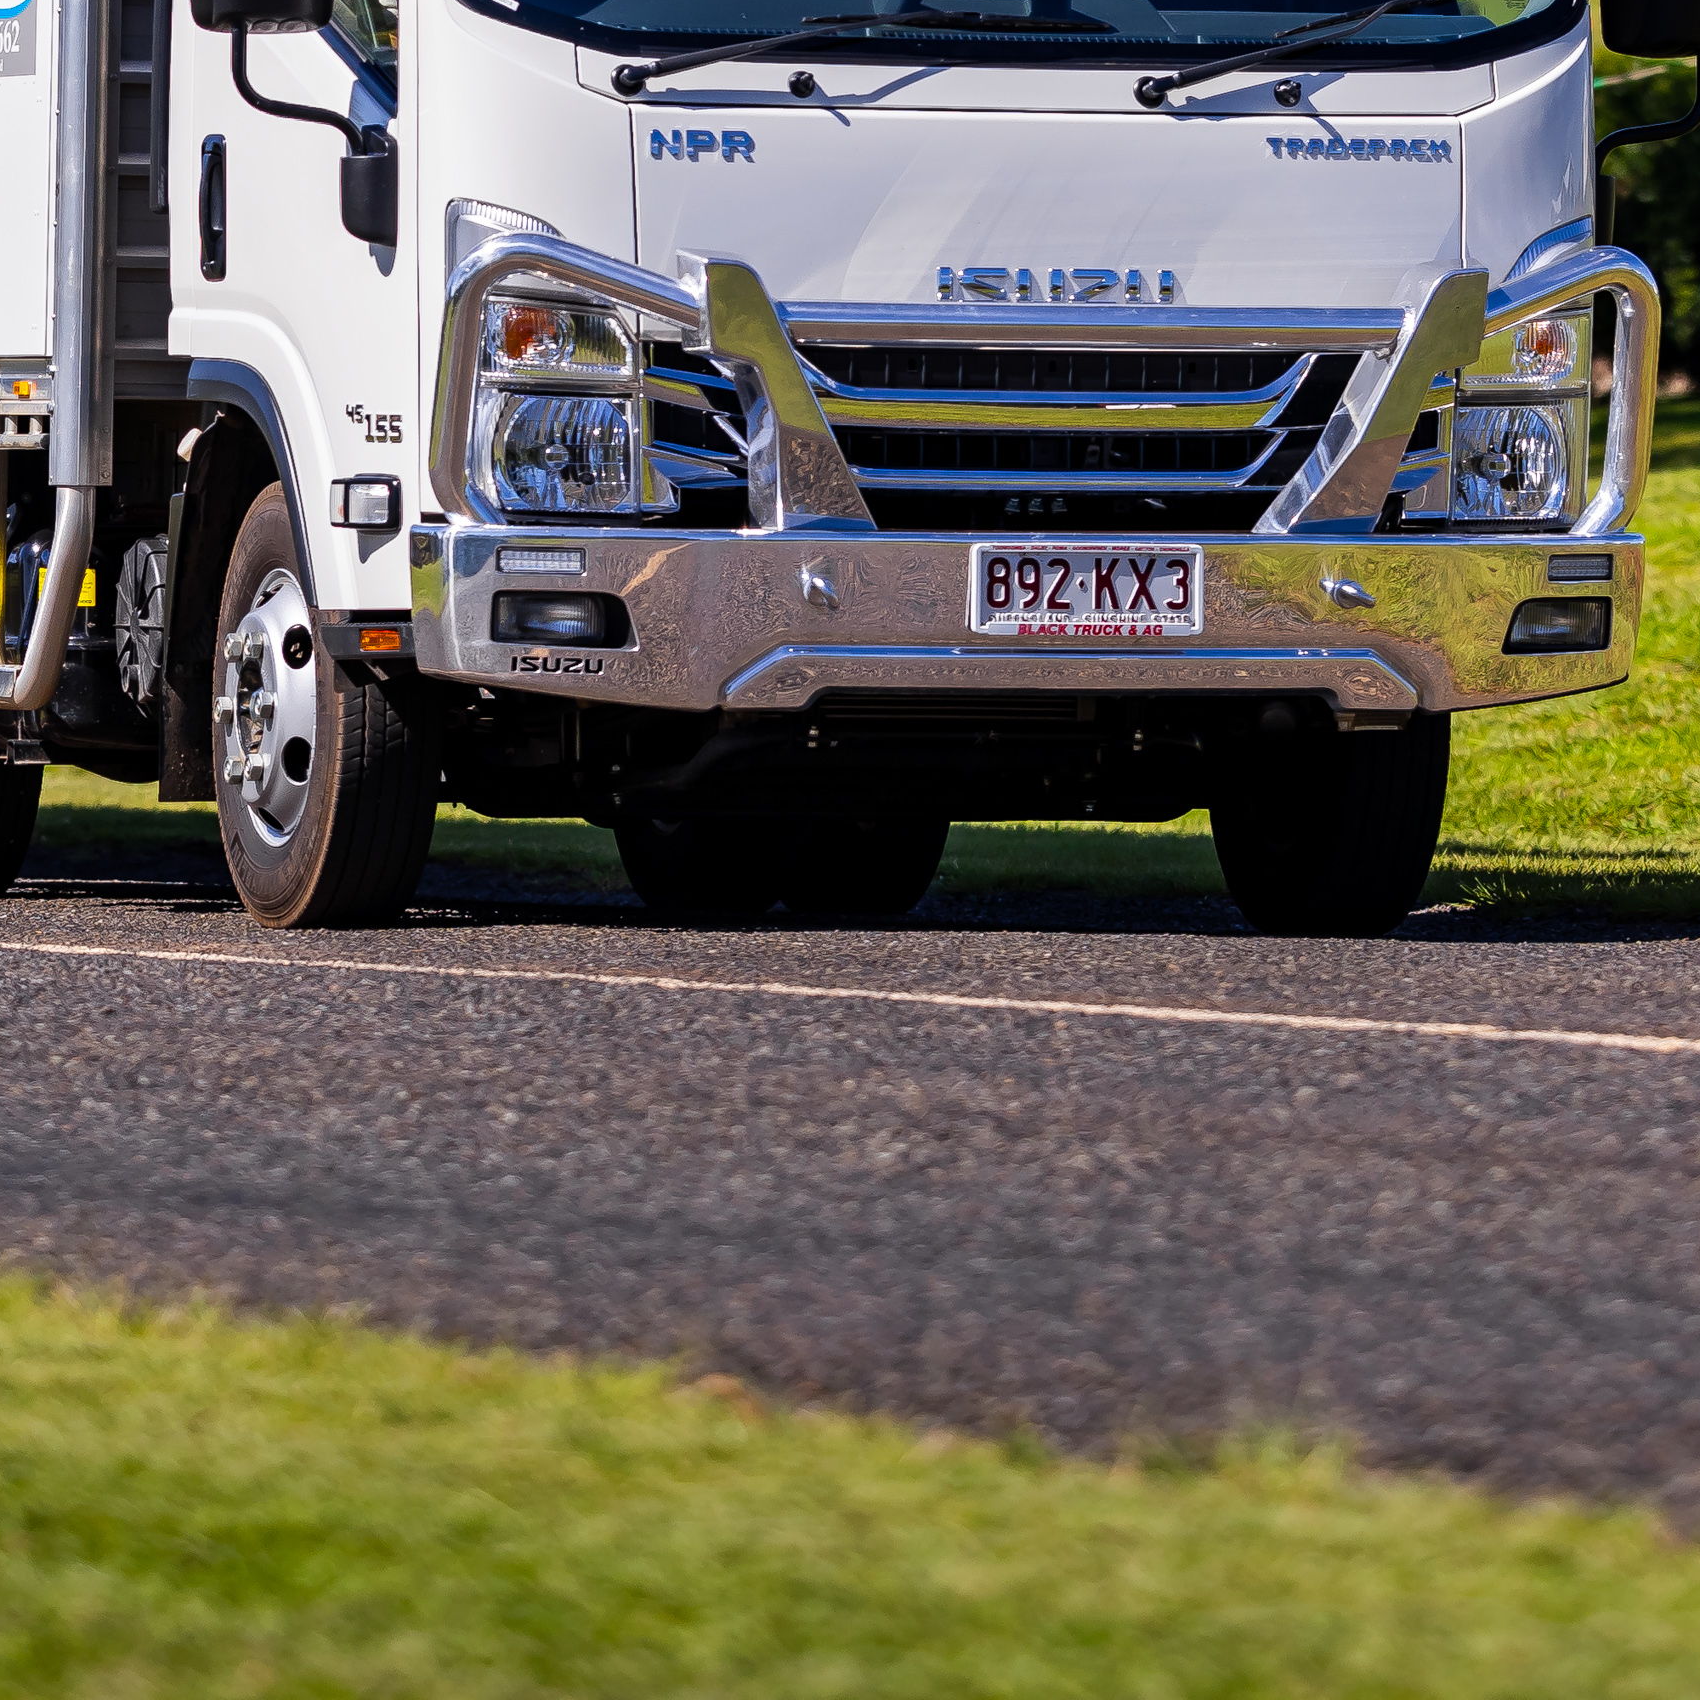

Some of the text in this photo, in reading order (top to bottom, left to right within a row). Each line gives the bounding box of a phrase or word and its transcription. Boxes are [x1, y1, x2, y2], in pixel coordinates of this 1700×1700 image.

[650, 129, 756, 162] NPR
[1266, 137, 1453, 162] TRADEPACK
[936, 266, 1174, 304] ISUZU
[346, 404, 403, 444] 45 155
[1017, 623, 1163, 636] BLACK TRUCK & AG
[510, 655, 604, 674] ISUZU
